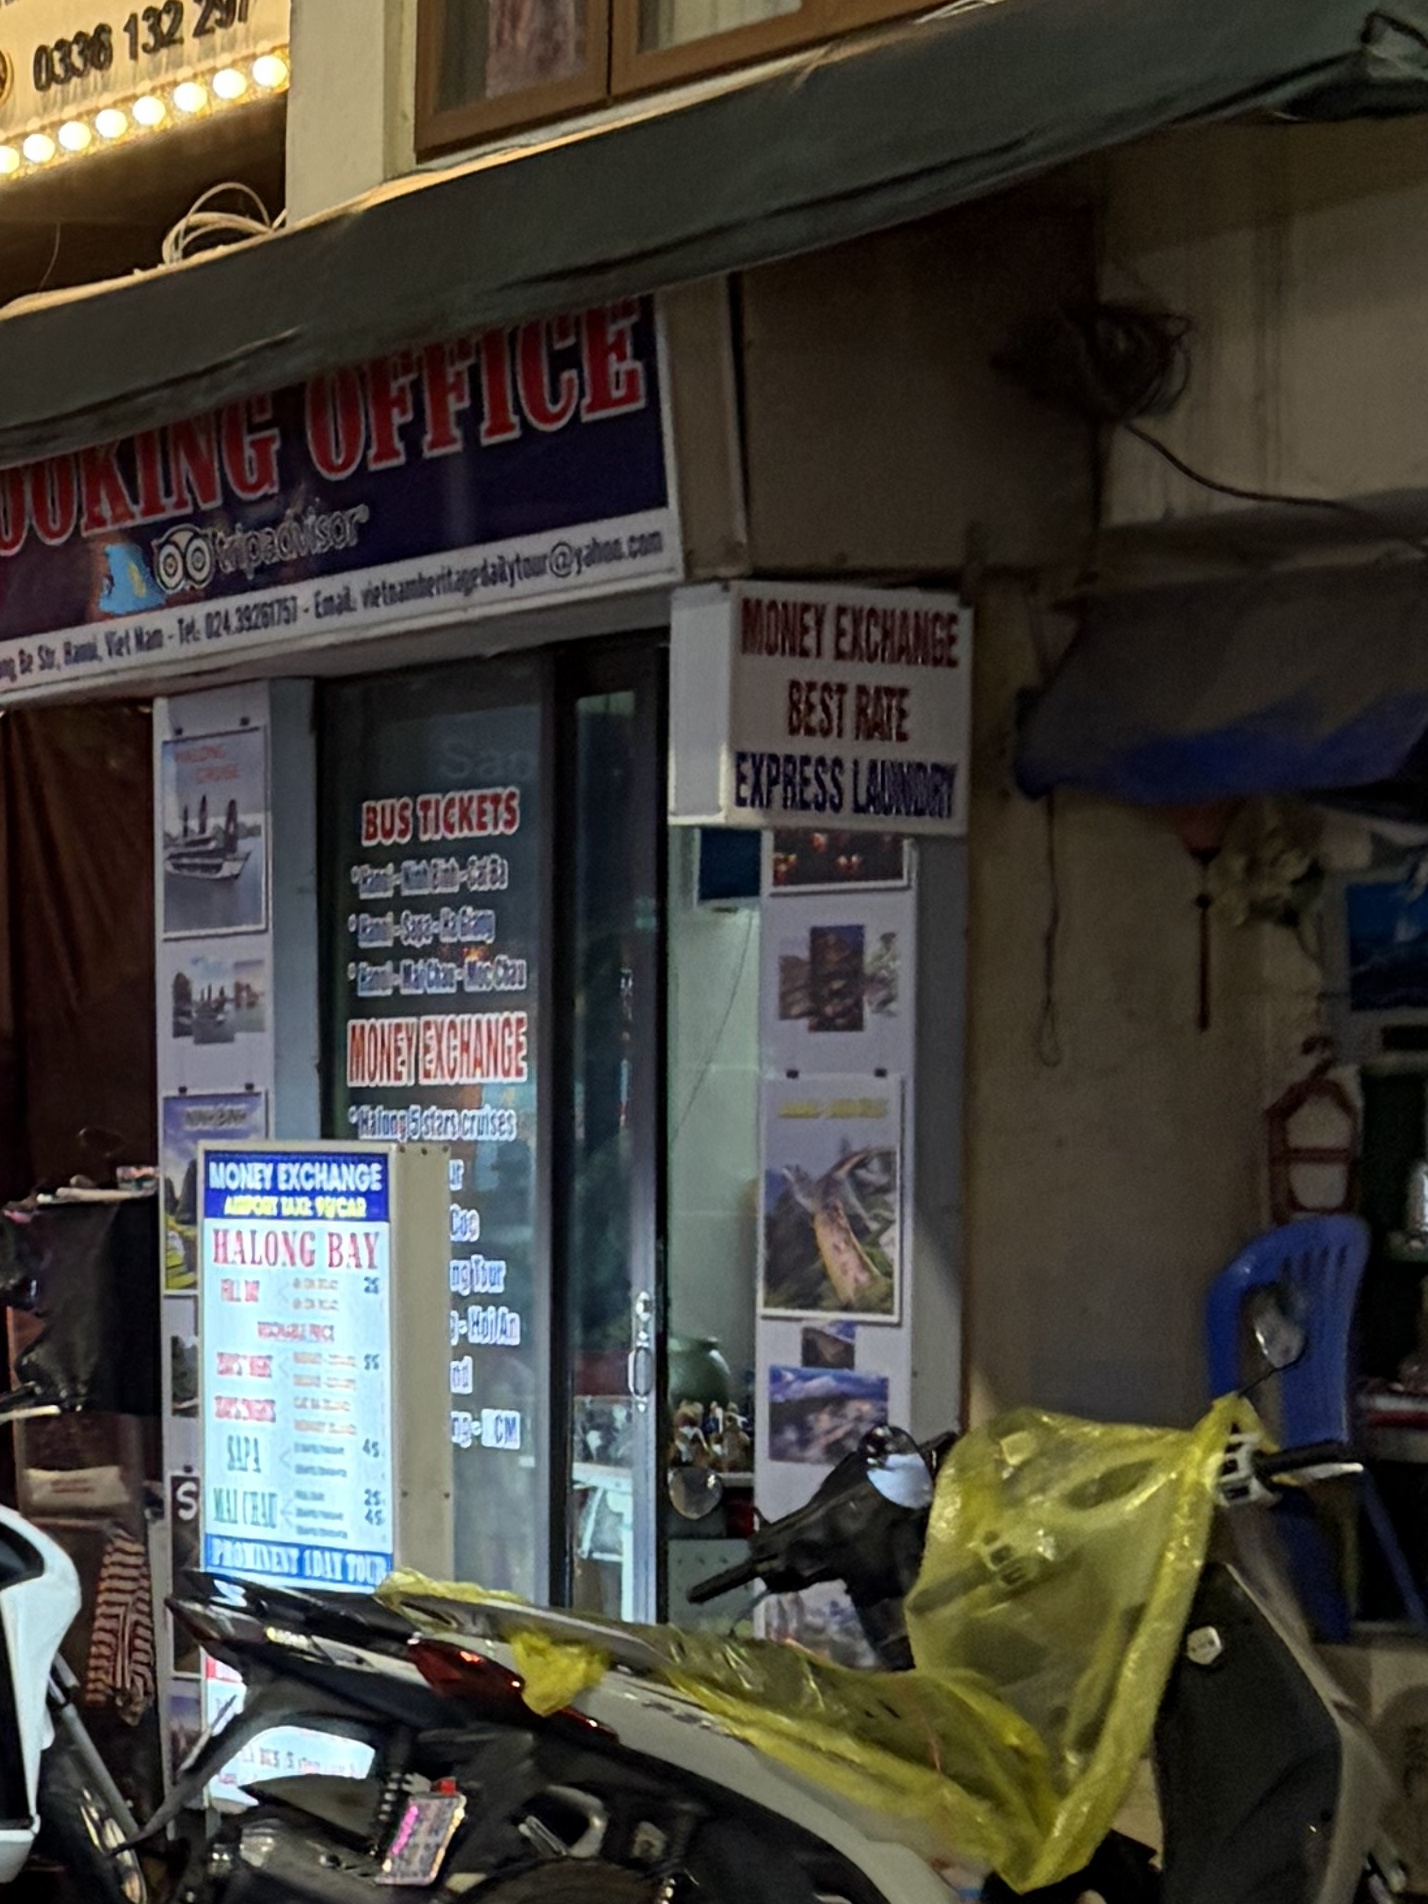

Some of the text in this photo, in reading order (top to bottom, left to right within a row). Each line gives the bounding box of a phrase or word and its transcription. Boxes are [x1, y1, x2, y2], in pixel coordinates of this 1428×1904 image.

[305, 294, 646, 481] OFFICE
[211, 506, 366, 579] tripadvisor
[739, 597, 960, 668] MONEY EXCHANGE
[787, 679, 911, 743] BEST RATE
[362, 786, 520, 847] BUS TICKETS
[734, 751, 960, 819] EXPRESS LAUNDRY
[347, 1011, 528, 1087] MONEY EXCHANGE
[460, 1104, 517, 1141] cruises
[209, 1161, 383, 1192] MONEY EXCHANGE
[213, 1228, 380, 1270] HALONG BAY
[227, 1434, 262, 1473] SAPA
